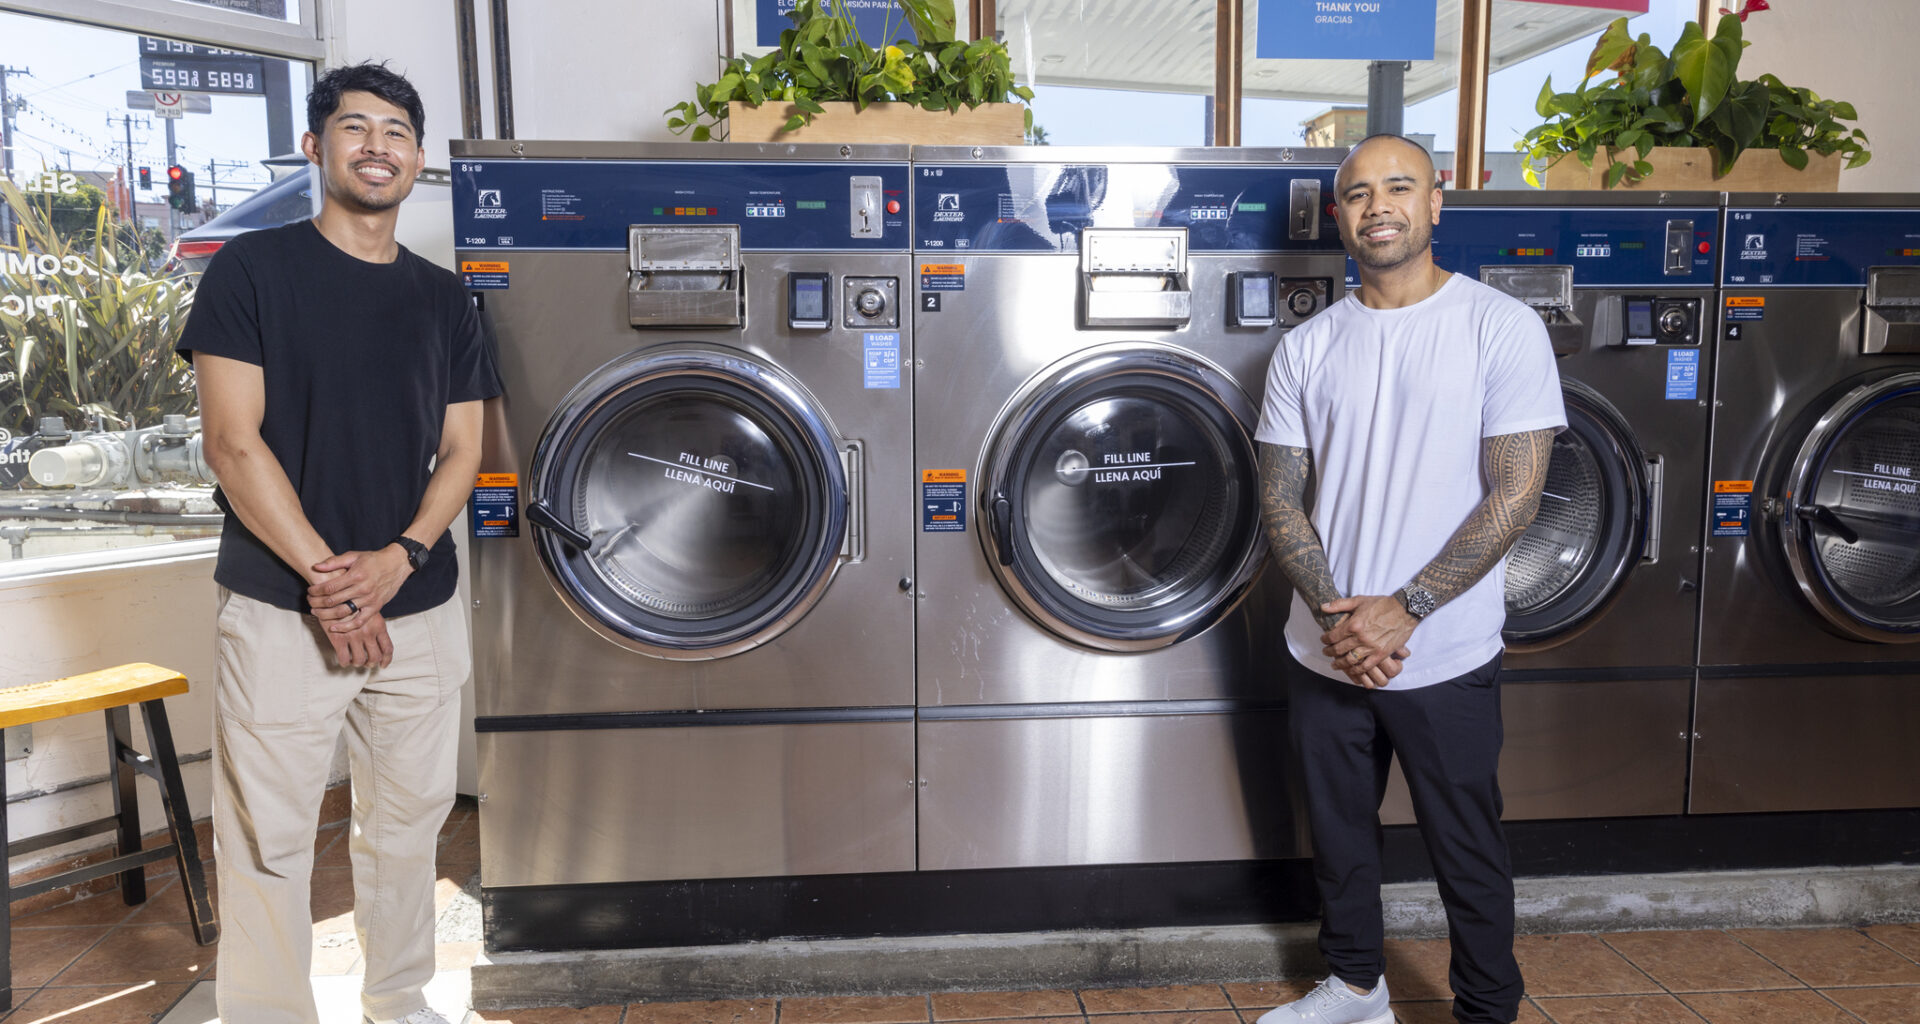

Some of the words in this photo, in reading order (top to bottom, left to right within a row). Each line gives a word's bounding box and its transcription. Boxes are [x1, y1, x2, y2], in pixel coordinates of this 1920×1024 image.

[871, 1, 893, 9] PARA
[1315, 2, 1352, 12] THANK
[1354, 2, 1380, 13] YOU!
[1314, 15, 1353, 24] GRACIAS
[461, 164, 467, 172] 8
[923, 169, 929, 177] 8
[465, 237, 486, 245] T-1200
[926, 297, 936, 308] 2
[1729, 327, 1738, 337] 4
[678, 452, 701, 467] FILL
[703, 457, 730, 474] LINE
[1103, 453, 1126, 465] FILL
[1127, 452, 1151, 463] LINE
[1095, 471, 1130, 483] LLENA
[1132, 466, 1162, 482] AQUÍ
[1873, 463, 1891, 474] FILL
[1892, 465, 1912, 477] LINE
[664, 467, 700, 486] LLENA
[703, 480, 737, 494] AQUÍ
[1863, 478, 1891, 491] LLENA
[1893, 482, 1917, 494] AQUÍ
